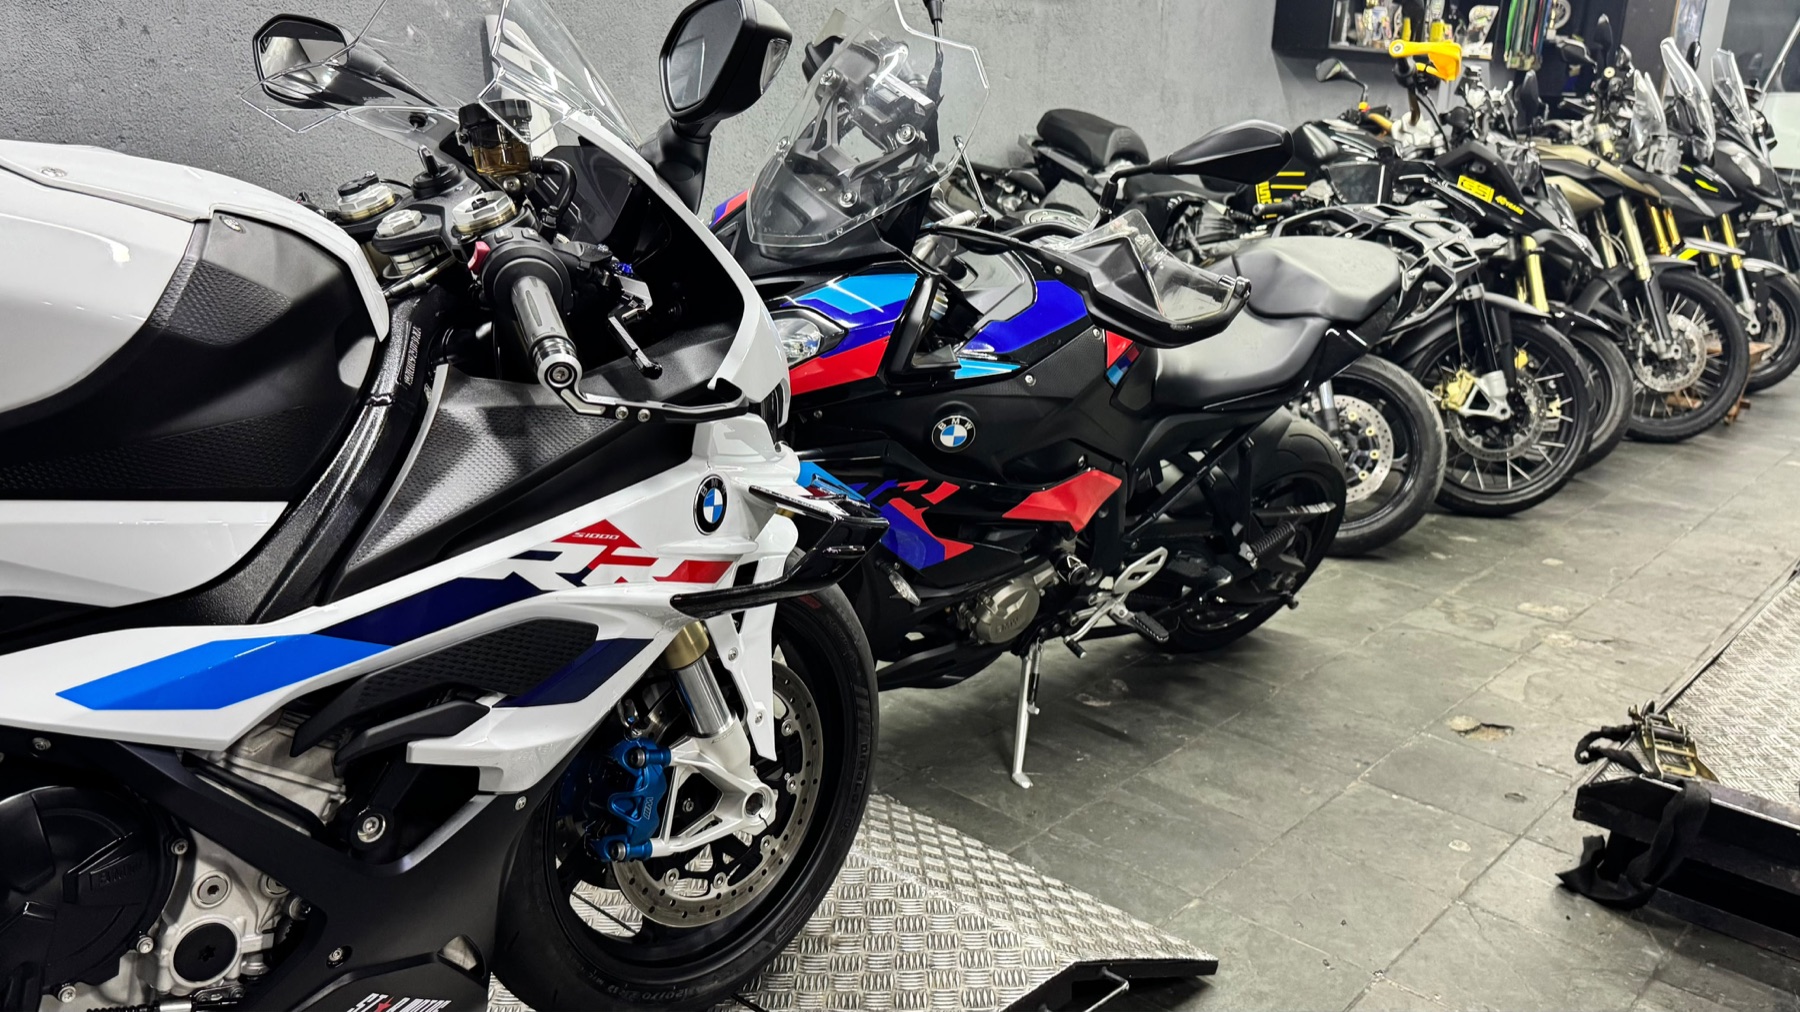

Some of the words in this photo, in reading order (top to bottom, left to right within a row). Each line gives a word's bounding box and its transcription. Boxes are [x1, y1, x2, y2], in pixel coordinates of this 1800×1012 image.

[938, 417, 973, 430] BMW
[700, 478, 728, 497] BMW
[572, 531, 620, 541] S1000
